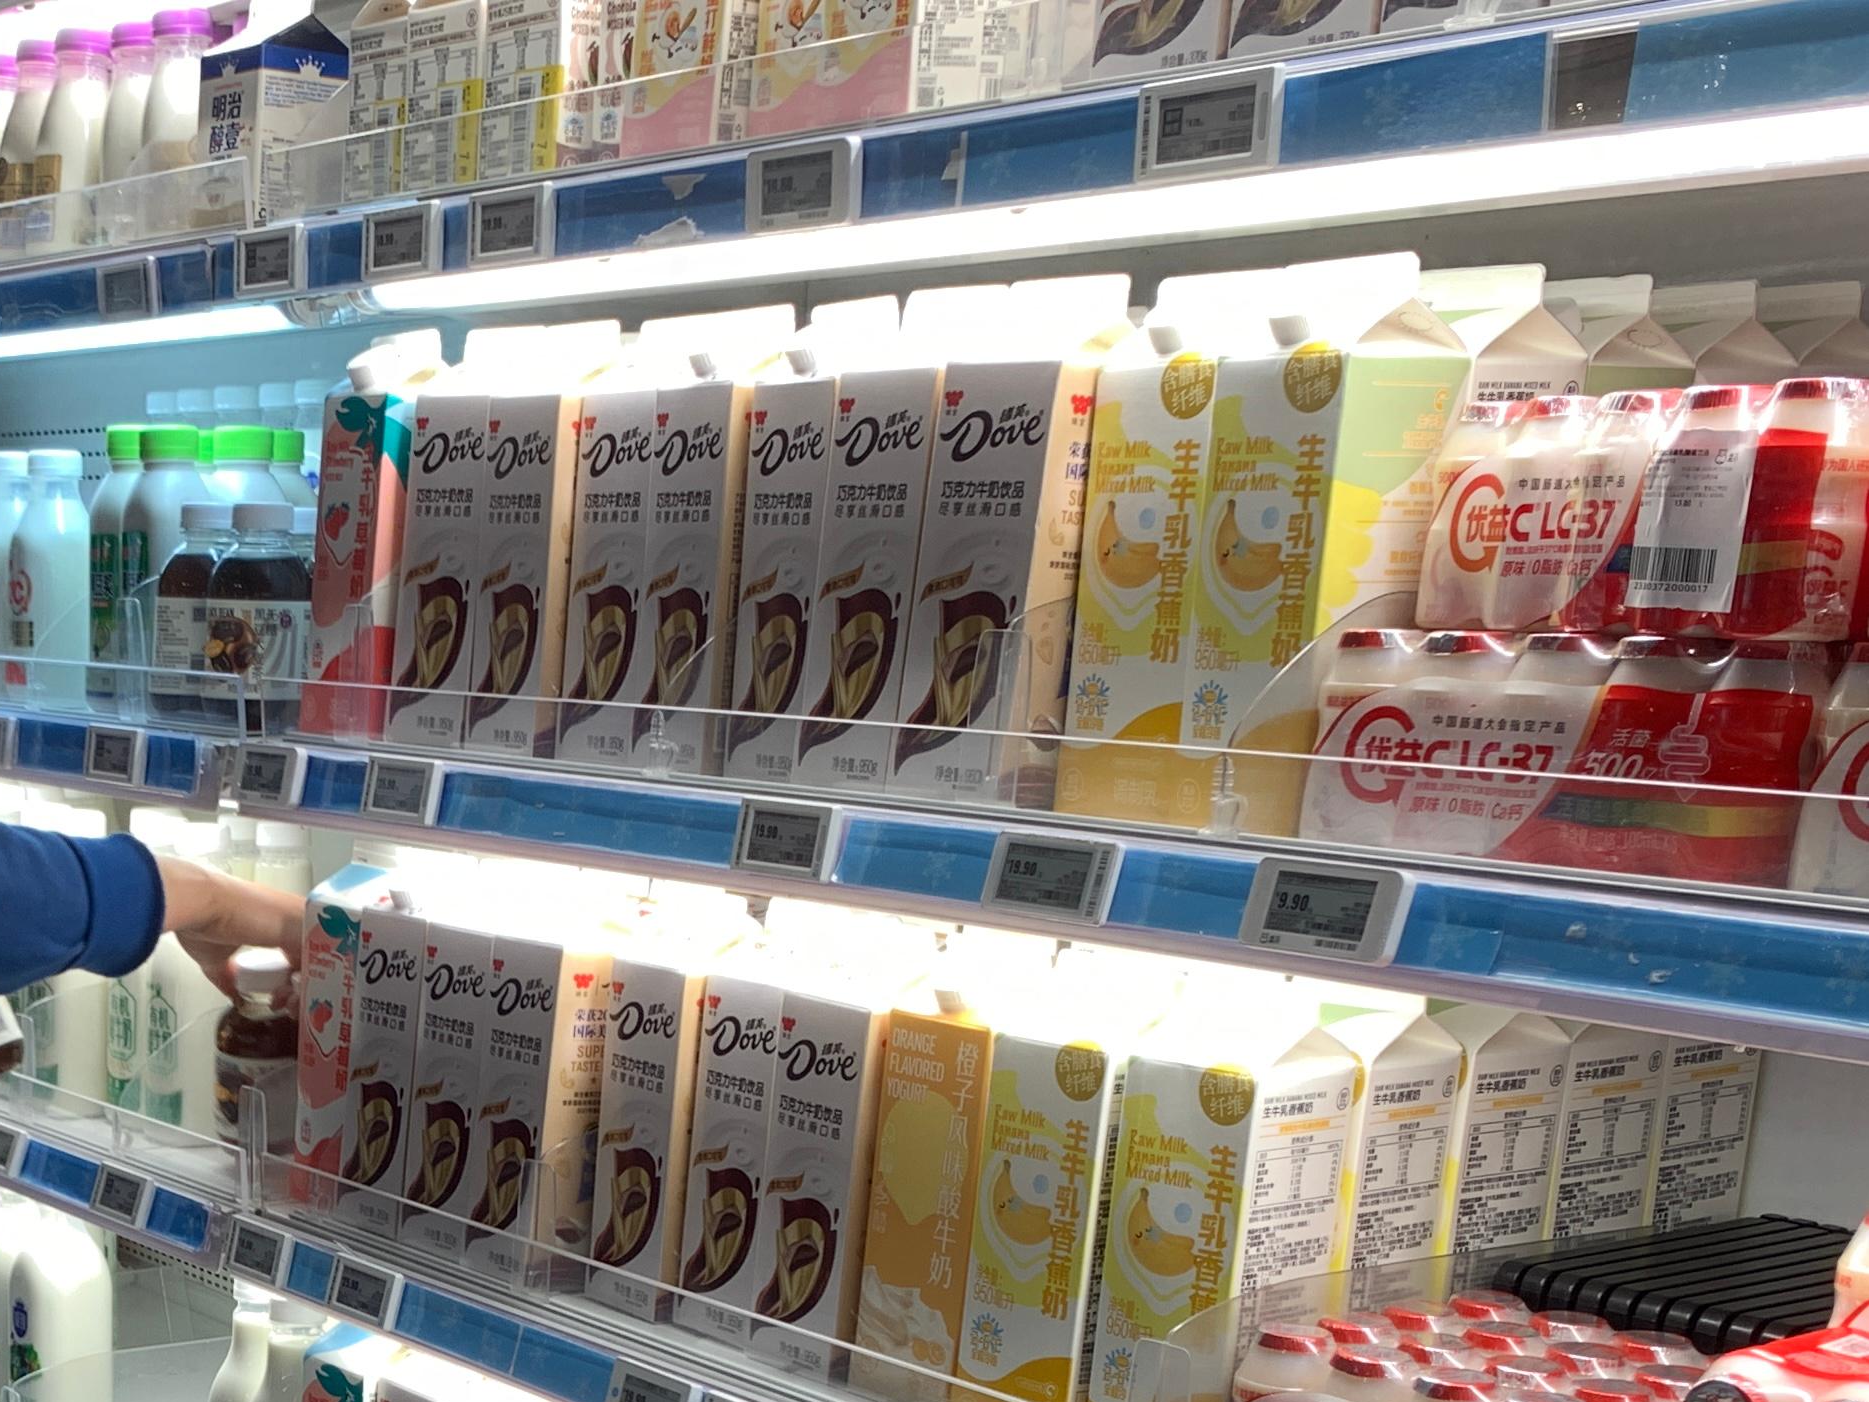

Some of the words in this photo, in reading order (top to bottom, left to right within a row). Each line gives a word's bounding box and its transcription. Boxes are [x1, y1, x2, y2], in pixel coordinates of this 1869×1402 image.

[211, 91, 243, 122] 明治
[414, 432, 486, 474] Dove
[654, 429, 723, 476] Dove
[752, 428, 825, 476] Dove
[835, 417, 924, 467] Dove
[940, 410, 1044, 462] Dove
[1126, 440, 1151, 458] Milk
[1246, 436, 1274, 454] Milk
[487, 436, 552, 480] Dove
[582, 433, 653, 478] Dove
[837, 483, 907, 501] 巧克力牛奶饮品
[941, 480, 1025, 499] 巧克力牛奶饮品
[1466, 501, 1536, 543] 优益C
[1540, 499, 1615, 540] LC-37
[1150, 438, 1201, 664] 生牛乳香蕉奶
[1269, 434, 1326, 668] 生牛乳香蕉奶
[1433, 713, 1566, 735] 中国肠道大会指定产品
[1610, 729, 1651, 748] 活菌
[1363, 735, 1451, 777] 优益C
[1456, 741, 1553, 785] LC-37
[1008, 859, 1038, 876] 19.90
[1277, 892, 1309, 912] 9.90
[360, 948, 418, 984] Dove
[424, 963, 485, 1000] Dove
[490, 978, 554, 1016] Dove
[610, 1002, 676, 1040] Dove
[705, 1016, 777, 1056] Dove
[779, 1039, 858, 1080] Dove
[893, 1028, 937, 1055] ORANGE
[889, 1056, 945, 1083] FLAVORED
[887, 1077, 928, 1103] YOGURT
[779, 1095, 843, 1125] 巧克力牛奶饮品
[1020, 1110, 1046, 1129] Milk
[926, 1039, 978, 1289] 橙子风味酸牛奶
[1160, 1135, 1188, 1155] Milk
[1041, 1119, 1090, 1321] 生牛乳香蕉奶
[1189, 1145, 1237, 1316] 生牛乳香蕉
